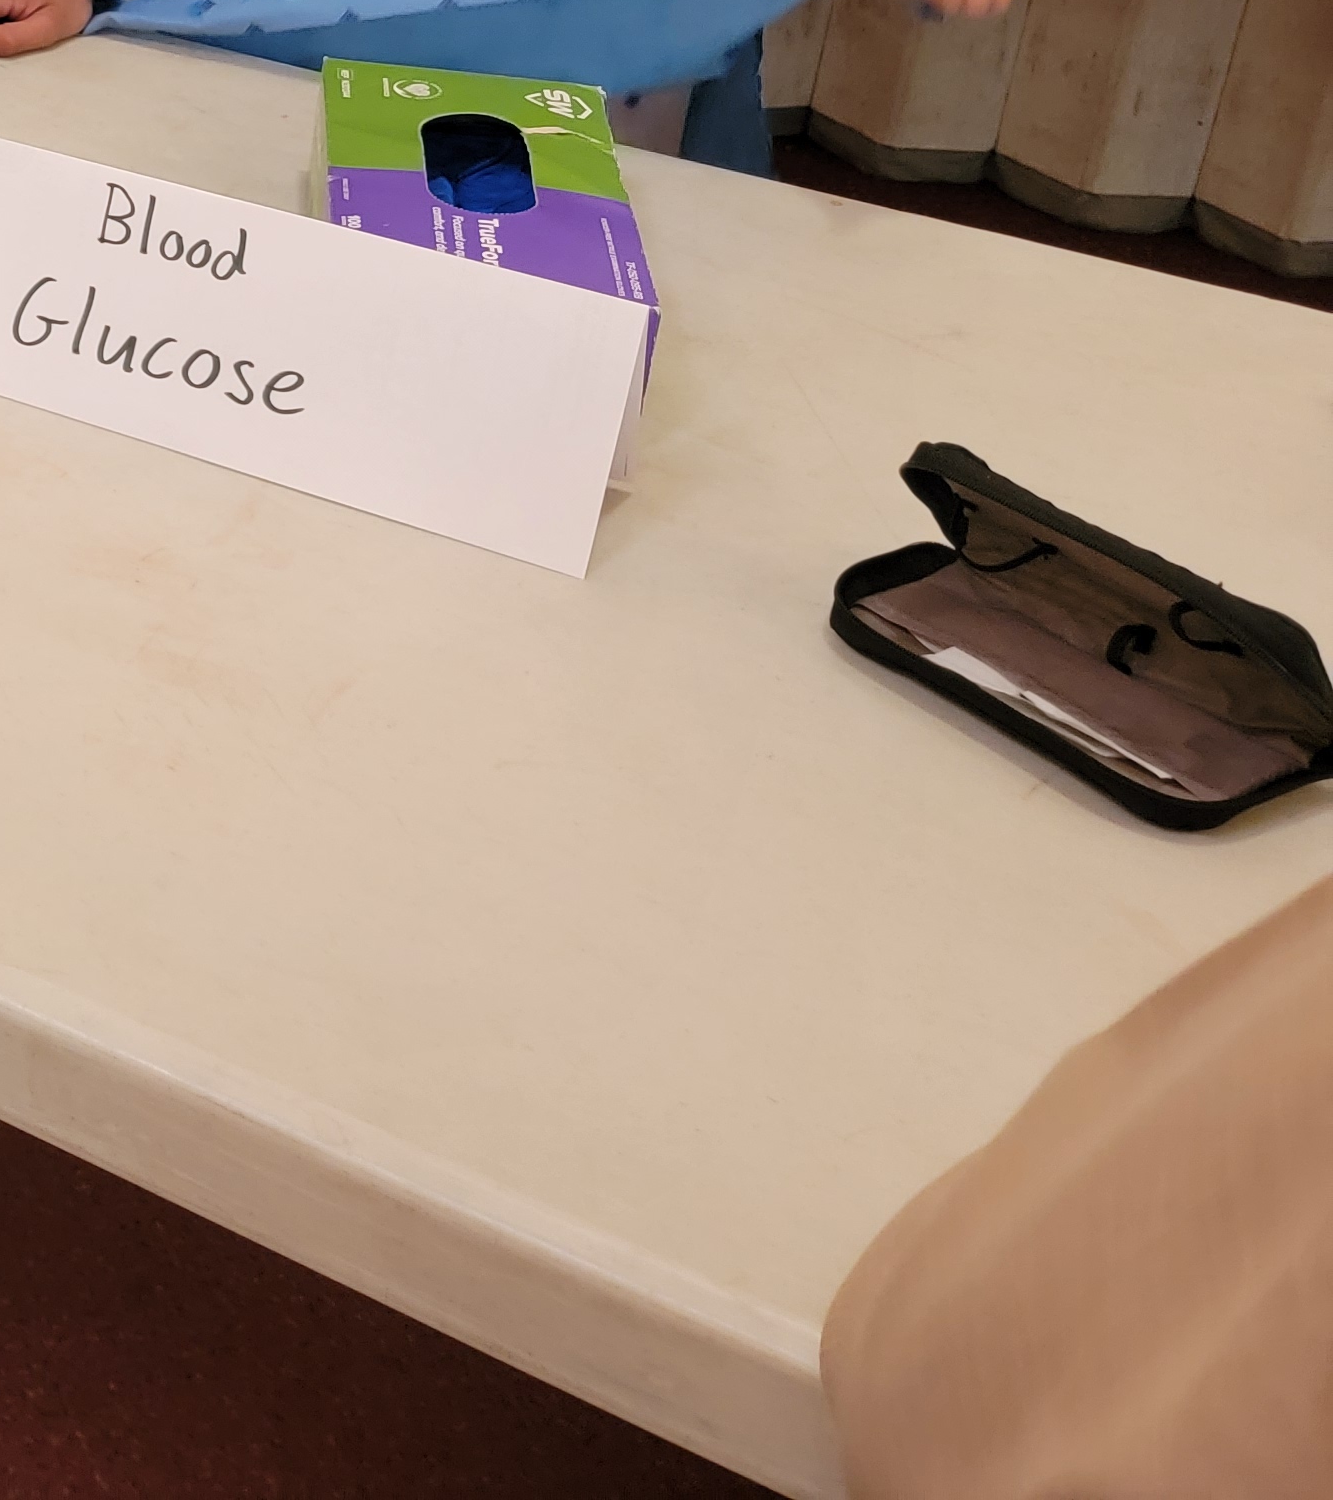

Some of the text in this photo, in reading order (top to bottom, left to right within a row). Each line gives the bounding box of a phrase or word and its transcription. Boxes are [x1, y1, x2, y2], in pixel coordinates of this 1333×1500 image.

[543, 88, 575, 119] SW
[98, 182, 247, 281] Blood
[347, 214, 362, 229] 100
[12, 276, 305, 415] Glucose
